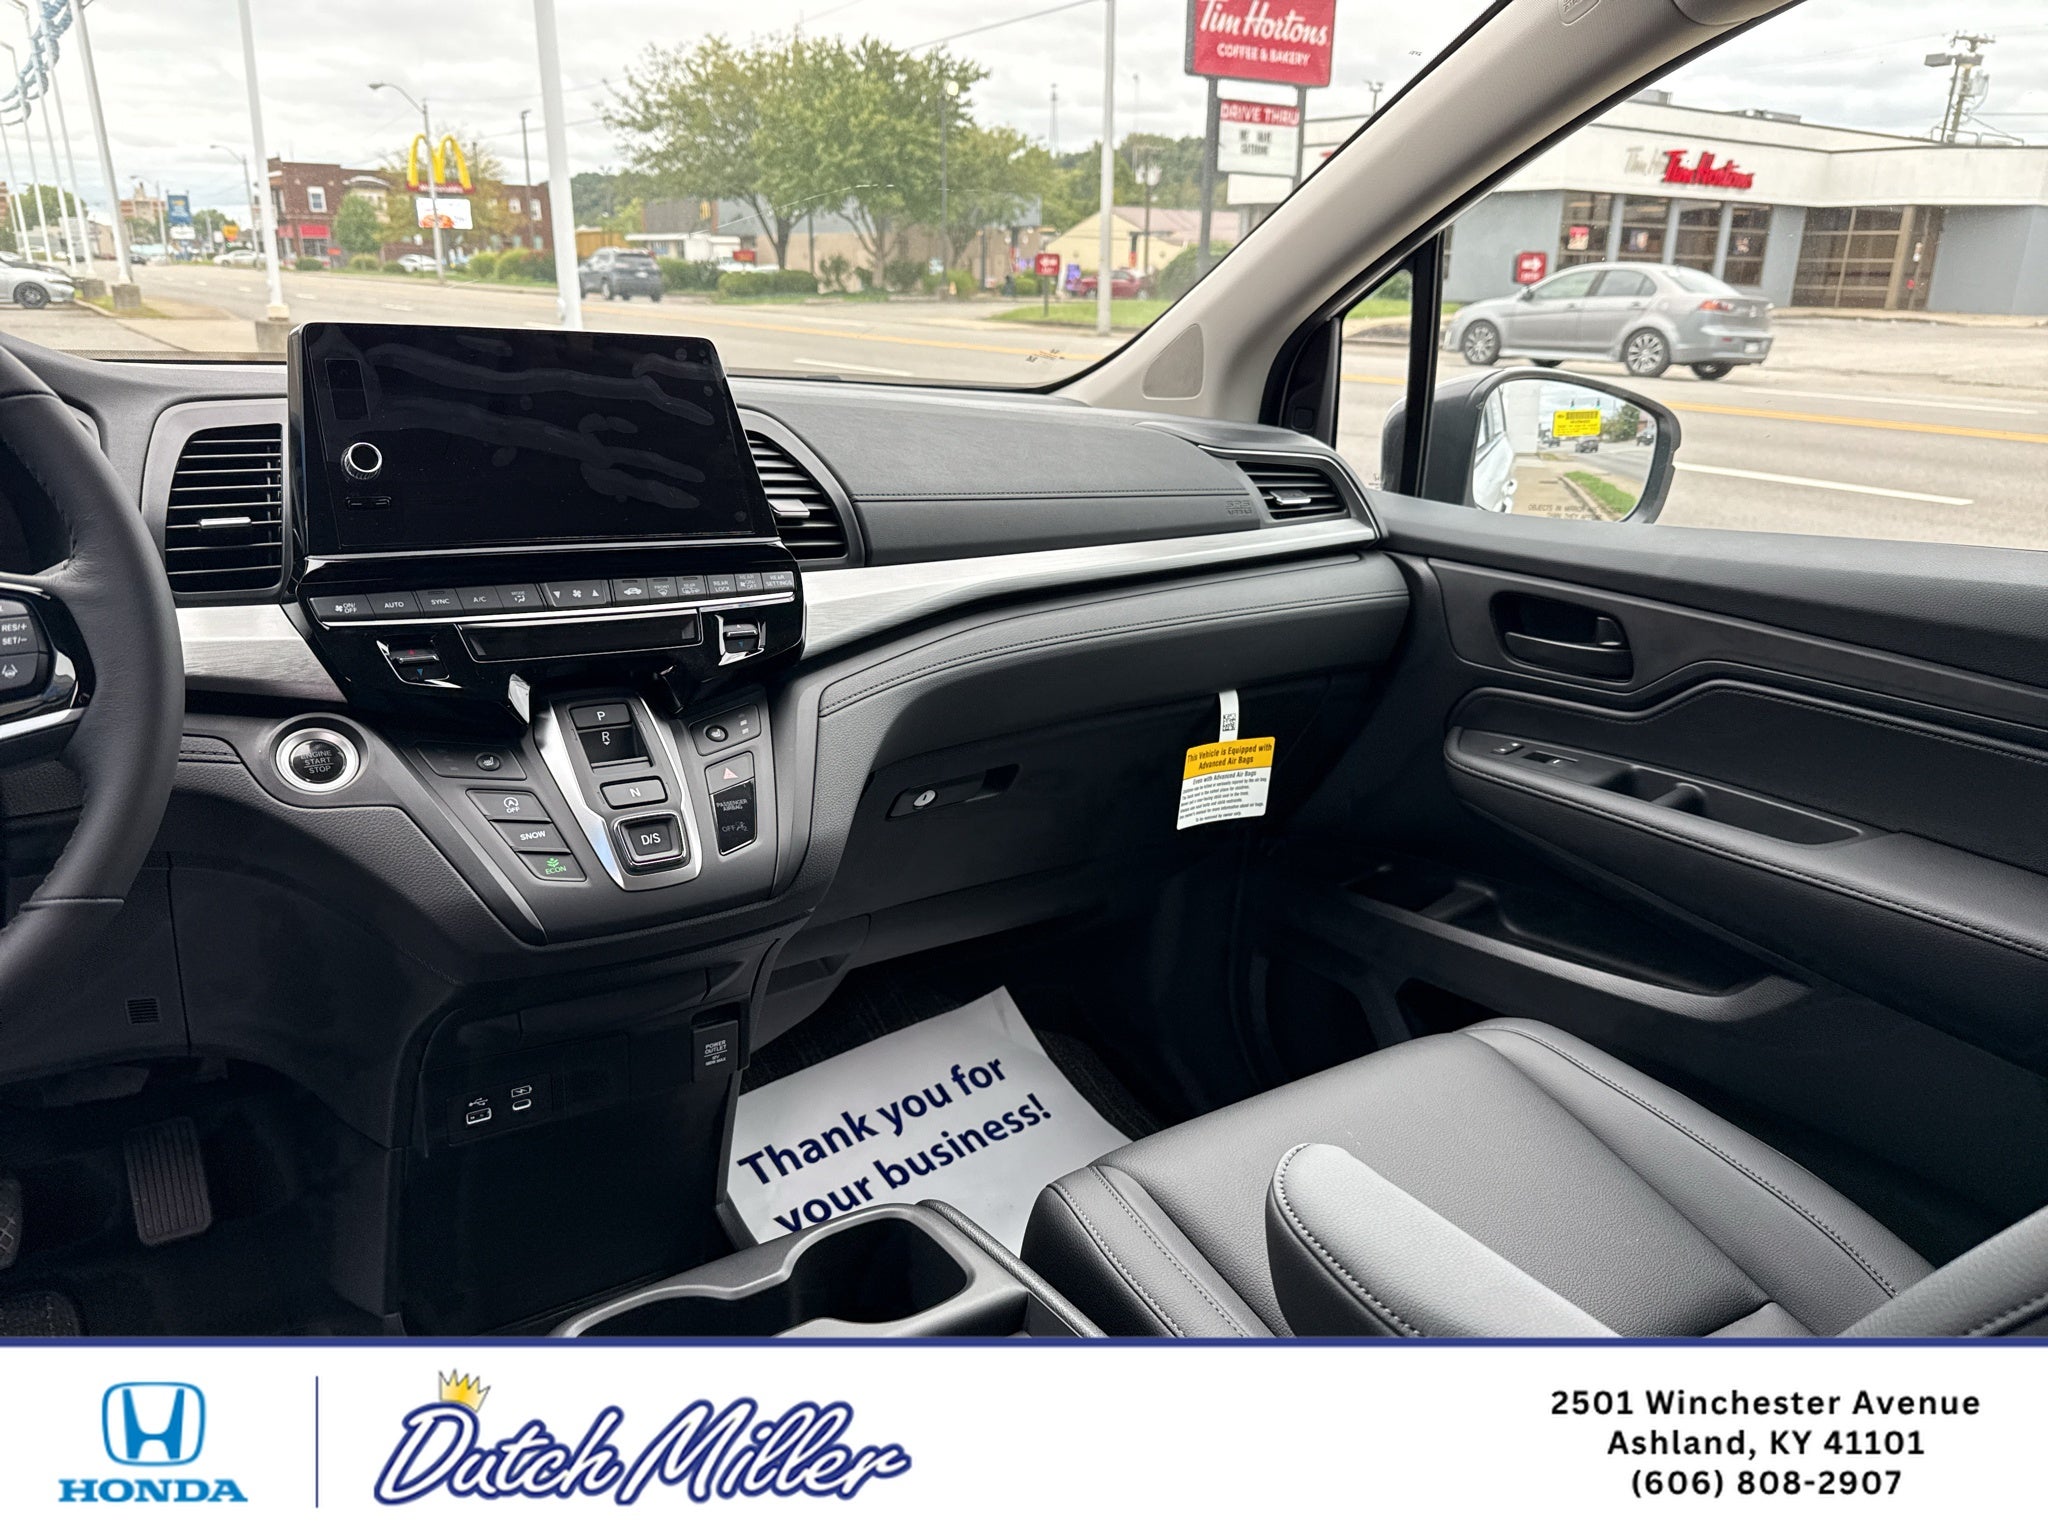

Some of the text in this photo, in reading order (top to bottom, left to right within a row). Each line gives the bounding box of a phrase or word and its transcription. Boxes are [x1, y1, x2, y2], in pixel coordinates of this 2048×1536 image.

[1200, 0, 1329, 46] Tim Hortons
[1217, 43, 1311, 67] COFFEE & BAKERY
[1220, 102, 1299, 126] DRIVE THRU
[1661, 149, 1695, 184] Tim
[384, 601, 405, 609] AUTO
[596, 711, 606, 721] P
[601, 731, 611, 743] R
[300, 750, 333, 760] ENGINE
[1187, 744, 1272, 763] This Vehicle is Equipped with
[304, 757, 331, 766] START
[1199, 756, 1254, 769] Advanced Air Bags
[308, 766, 331, 774] STOP
[629, 787, 642, 798] N
[716, 799, 748, 807] PASSENGER
[721, 825, 736, 833] OFF
[520, 830, 546, 841] SNOW
[640, 832, 661, 846] D/S
[545, 865, 567, 875] ECON
[704, 1045, 727, 1055] OUTLET
[705, 1040, 726, 1050] POWER
[736, 1057, 1006, 1186] Thank you for
[773, 1092, 1052, 1235] your business!
